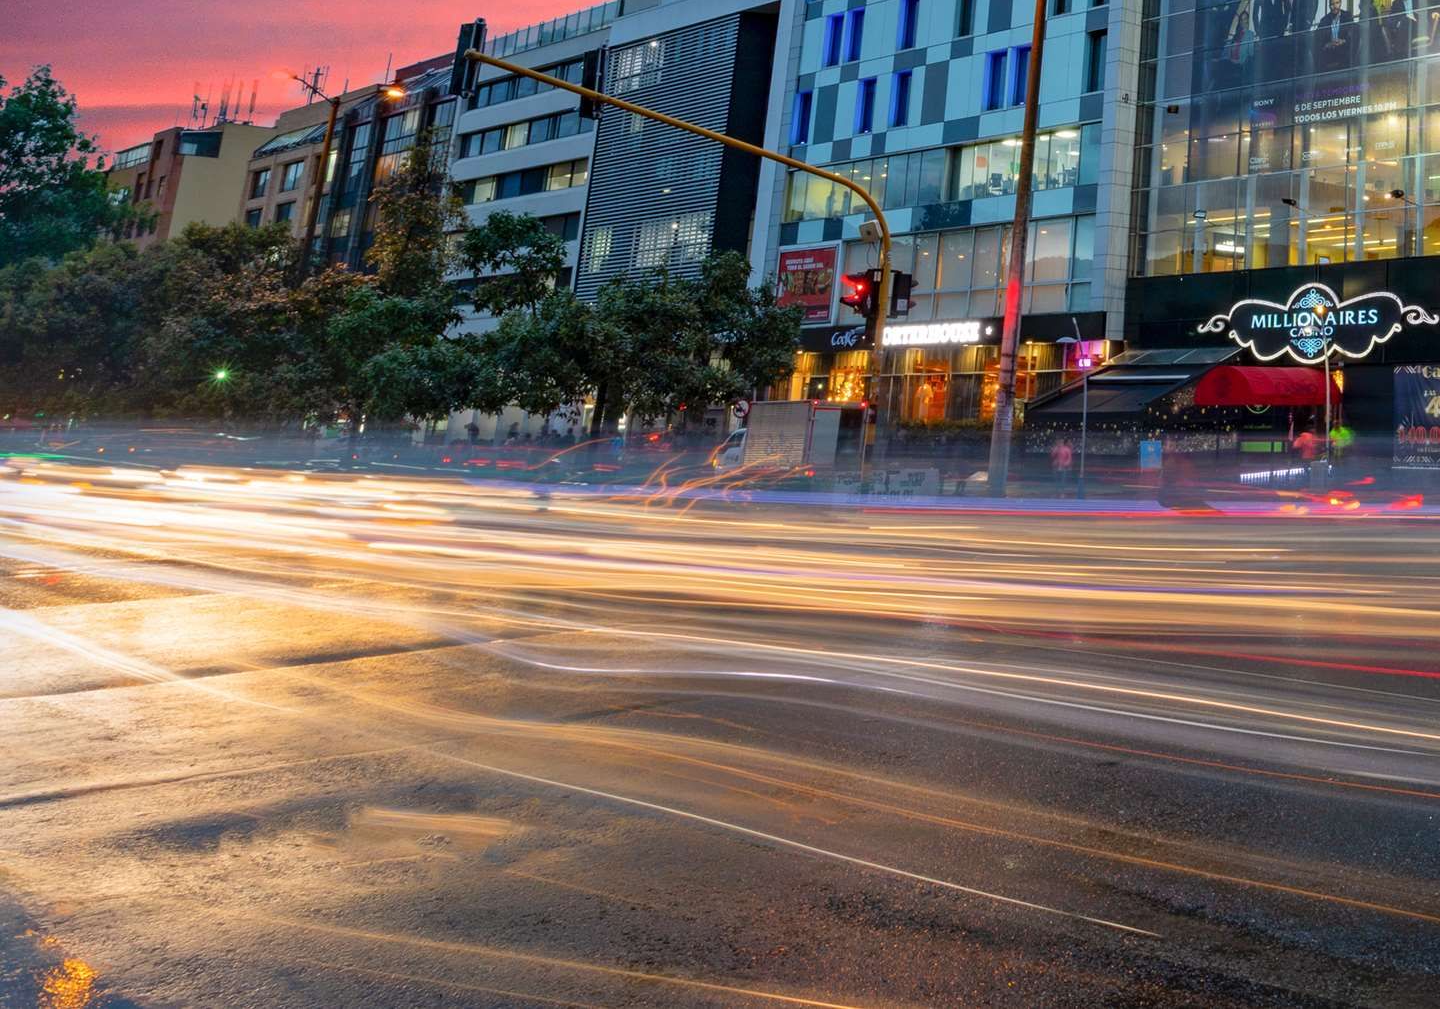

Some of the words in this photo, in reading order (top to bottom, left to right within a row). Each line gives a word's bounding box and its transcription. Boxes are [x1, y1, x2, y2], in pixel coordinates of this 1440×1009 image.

[1294, 104, 1299, 113] 6
[1301, 102, 1312, 111] DE
[1313, 95, 1361, 110] SEPTIEMBRE
[1294, 114, 1321, 124] TODOS
[1322, 111, 1337, 120] LOS
[1338, 105, 1373, 117] VIERNES
[1251, 309, 1378, 329] MILLIONAIRES
